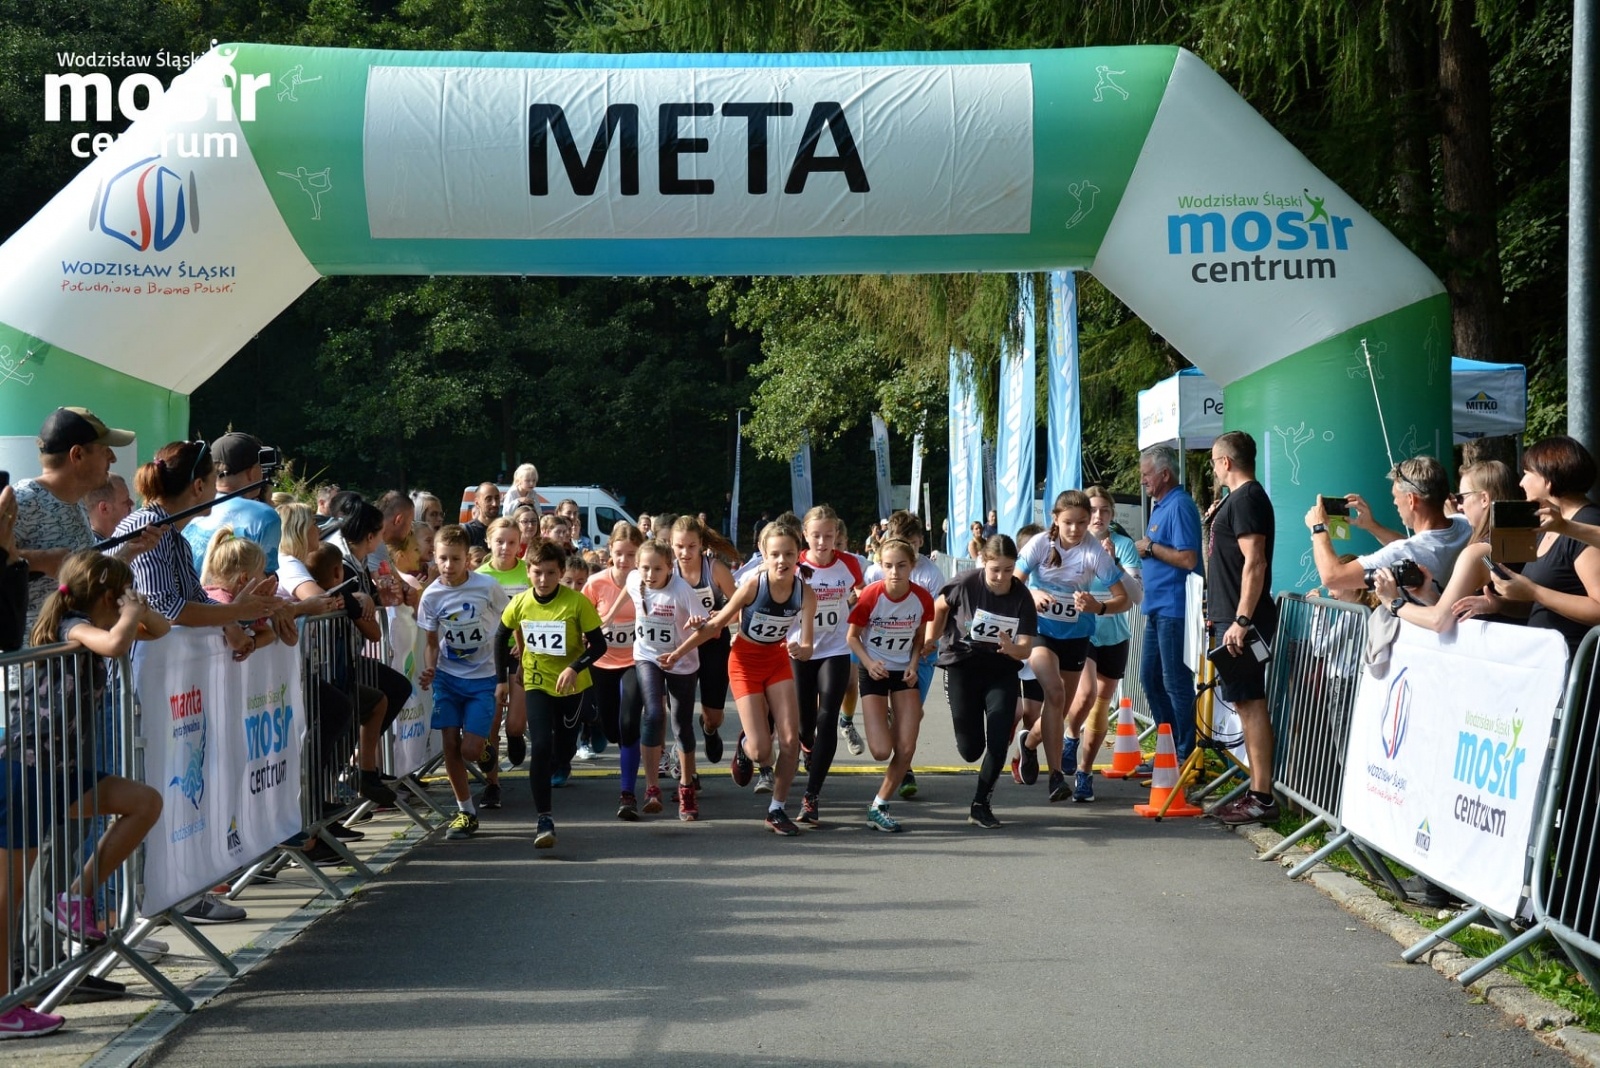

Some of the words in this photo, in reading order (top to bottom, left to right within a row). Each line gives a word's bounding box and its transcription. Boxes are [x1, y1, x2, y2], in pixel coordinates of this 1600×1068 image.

[529, 101, 870, 196] META
[1178, 194, 1258, 209] Wodzisław
[1262, 191, 1303, 210] Śląski
[1167, 208, 1355, 254] mosir
[61, 260, 172, 278] WODZISŁAW
[178, 260, 236, 281] ŚLĄSKI
[1191, 255, 1337, 283] centrum
[147, 281, 190, 295] Brama
[193, 281, 236, 294] Polski
[1466, 401, 1498, 410] MITKO
[801, 611, 838, 627] 10
[445, 628, 483, 644] 414
[604, 631, 636, 644] 401
[637, 625, 671, 643] 415
[750, 623, 790, 638] 425
[526, 633, 563, 649] 412
[870, 636, 910, 651] 417
[170, 684, 202, 721] manta
[245, 704, 293, 763] mosir
[399, 720, 425, 741] ALATON
[1453, 730, 1526, 800] mosir
[250, 759, 287, 795] centrum
[1454, 794, 1507, 838] centrum
